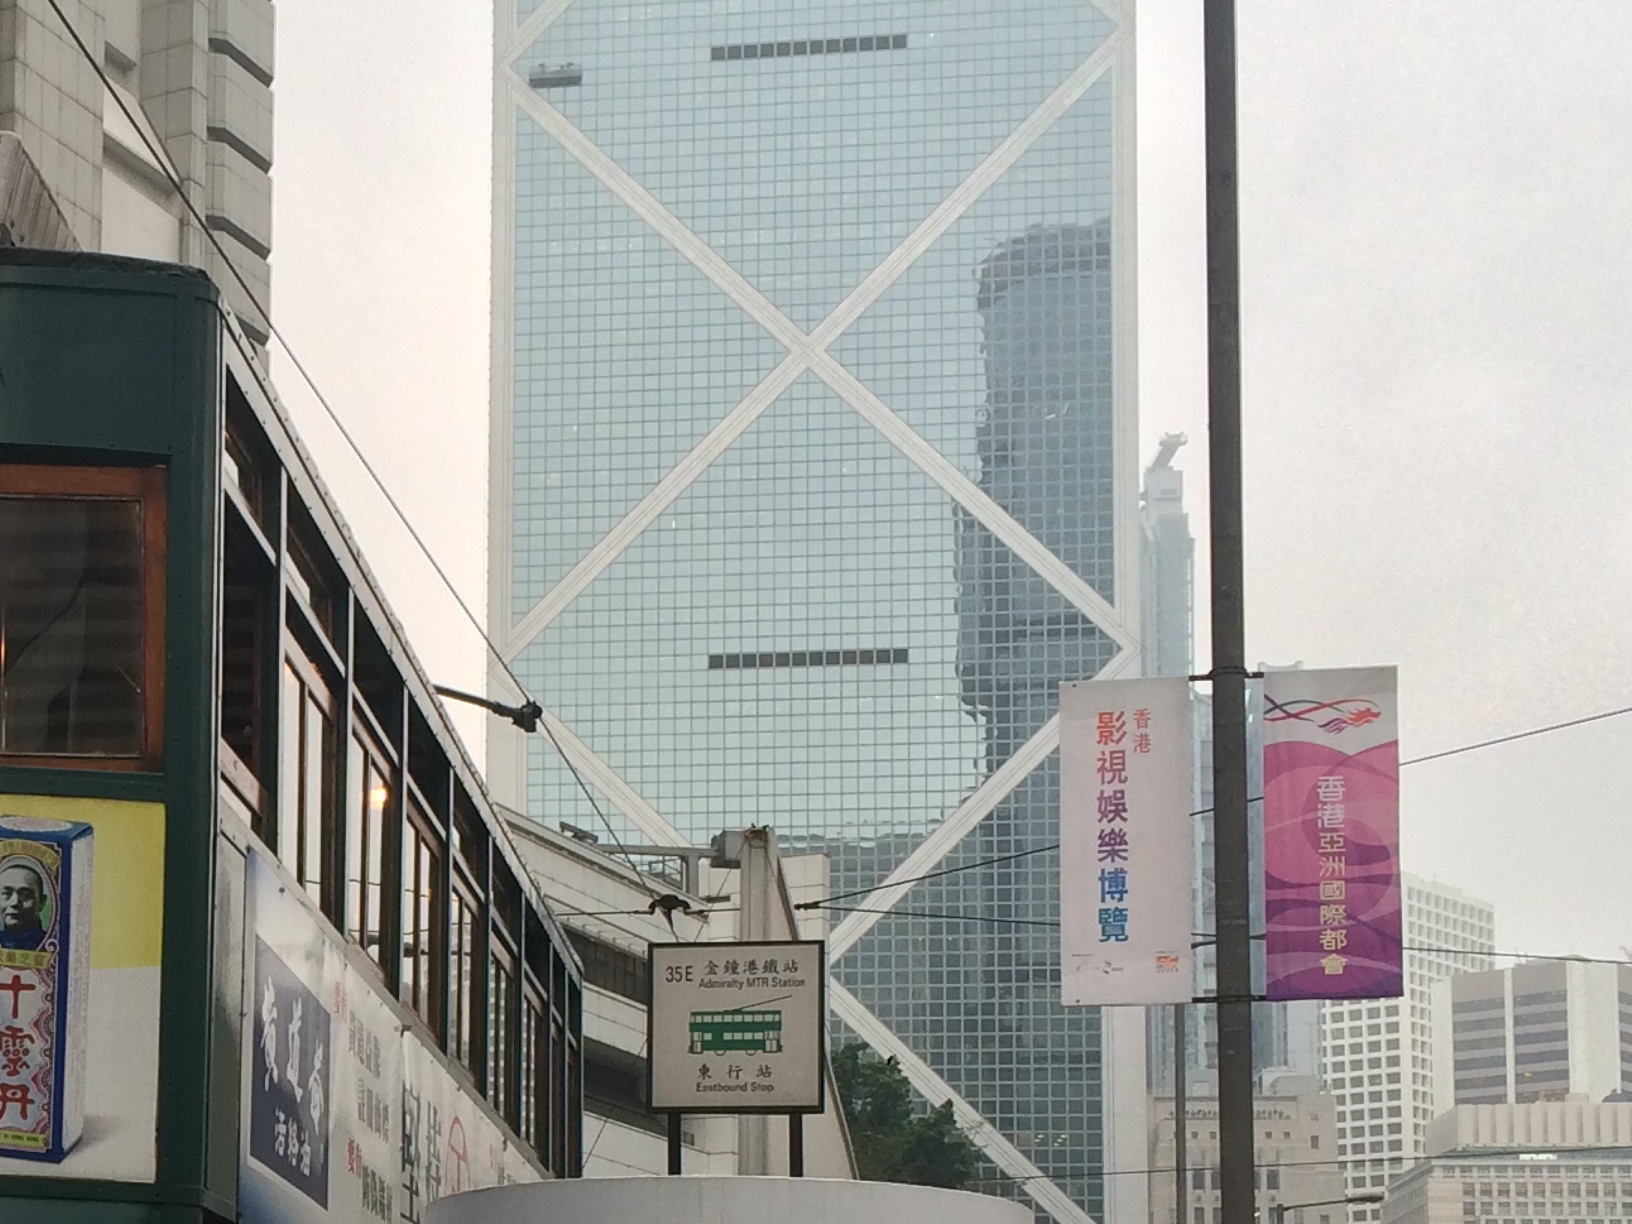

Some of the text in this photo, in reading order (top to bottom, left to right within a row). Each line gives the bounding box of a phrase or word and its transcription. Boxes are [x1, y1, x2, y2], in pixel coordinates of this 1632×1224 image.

[1132, 708, 1152, 754] 香港
[1096, 710, 1129, 943] 影視娛樂博覽
[1317, 775, 1348, 975] 香港亞洲國際都會
[665, 965, 694, 983] 35E
[704, 959, 799, 976] 金鐘港鐵站
[698, 976, 806, 990] Admiralty MTR Station
[697, 1063, 773, 1080] 東行站
[696, 1081, 775, 1093] Eastbound Stop
